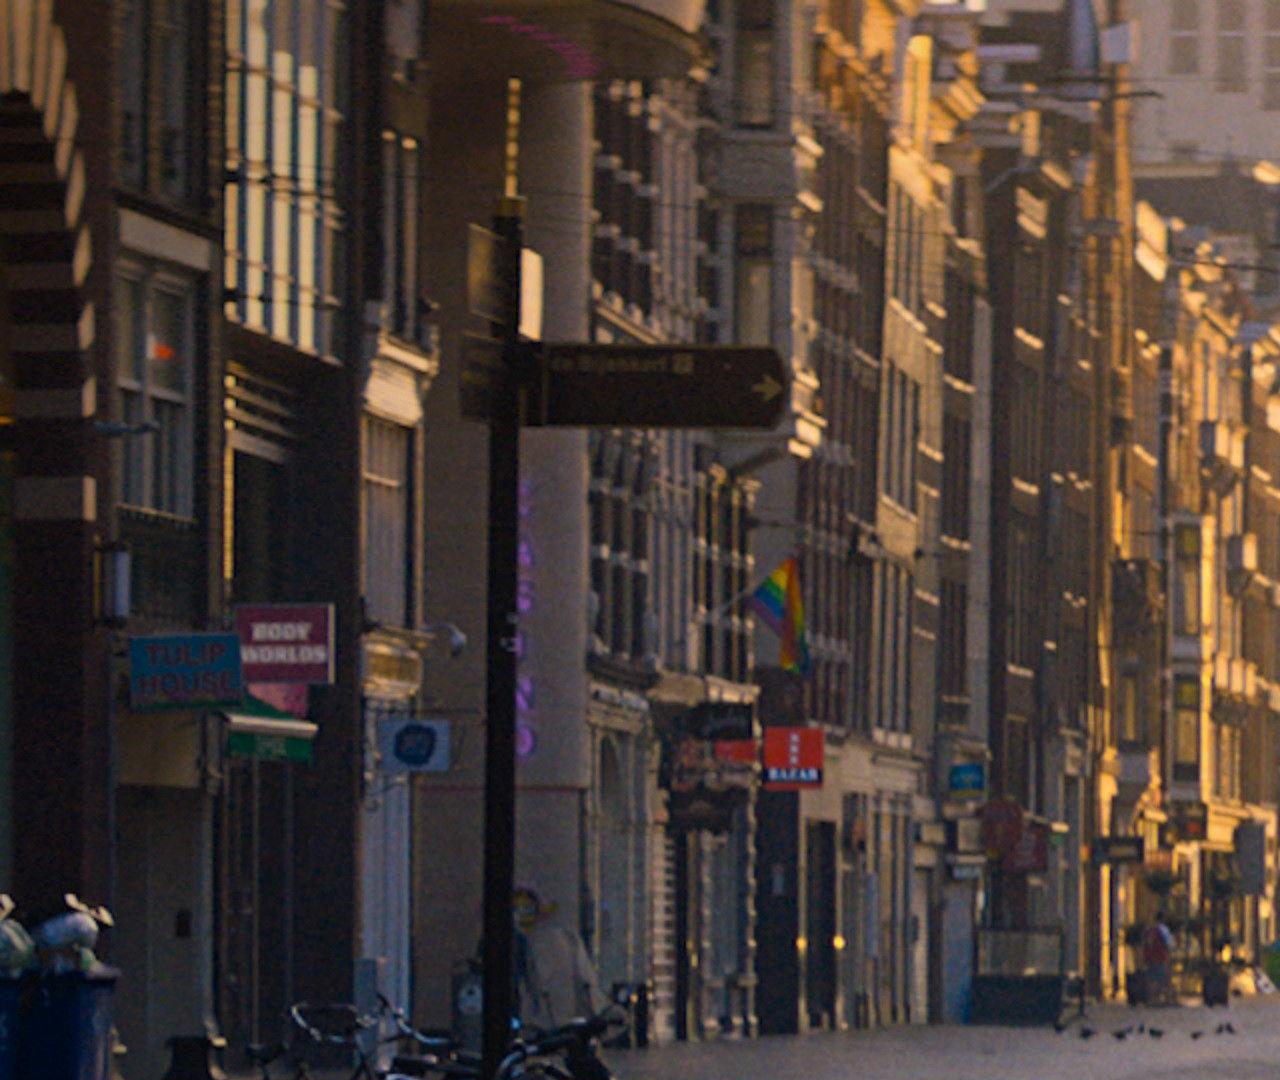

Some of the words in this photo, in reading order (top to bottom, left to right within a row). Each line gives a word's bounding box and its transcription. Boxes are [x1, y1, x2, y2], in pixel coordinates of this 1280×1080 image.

[252, 622, 312, 641] BODY
[146, 643, 226, 667] TULIP
[241, 644, 326, 664] WORLDS
[137, 671, 232, 697] HOUSE
